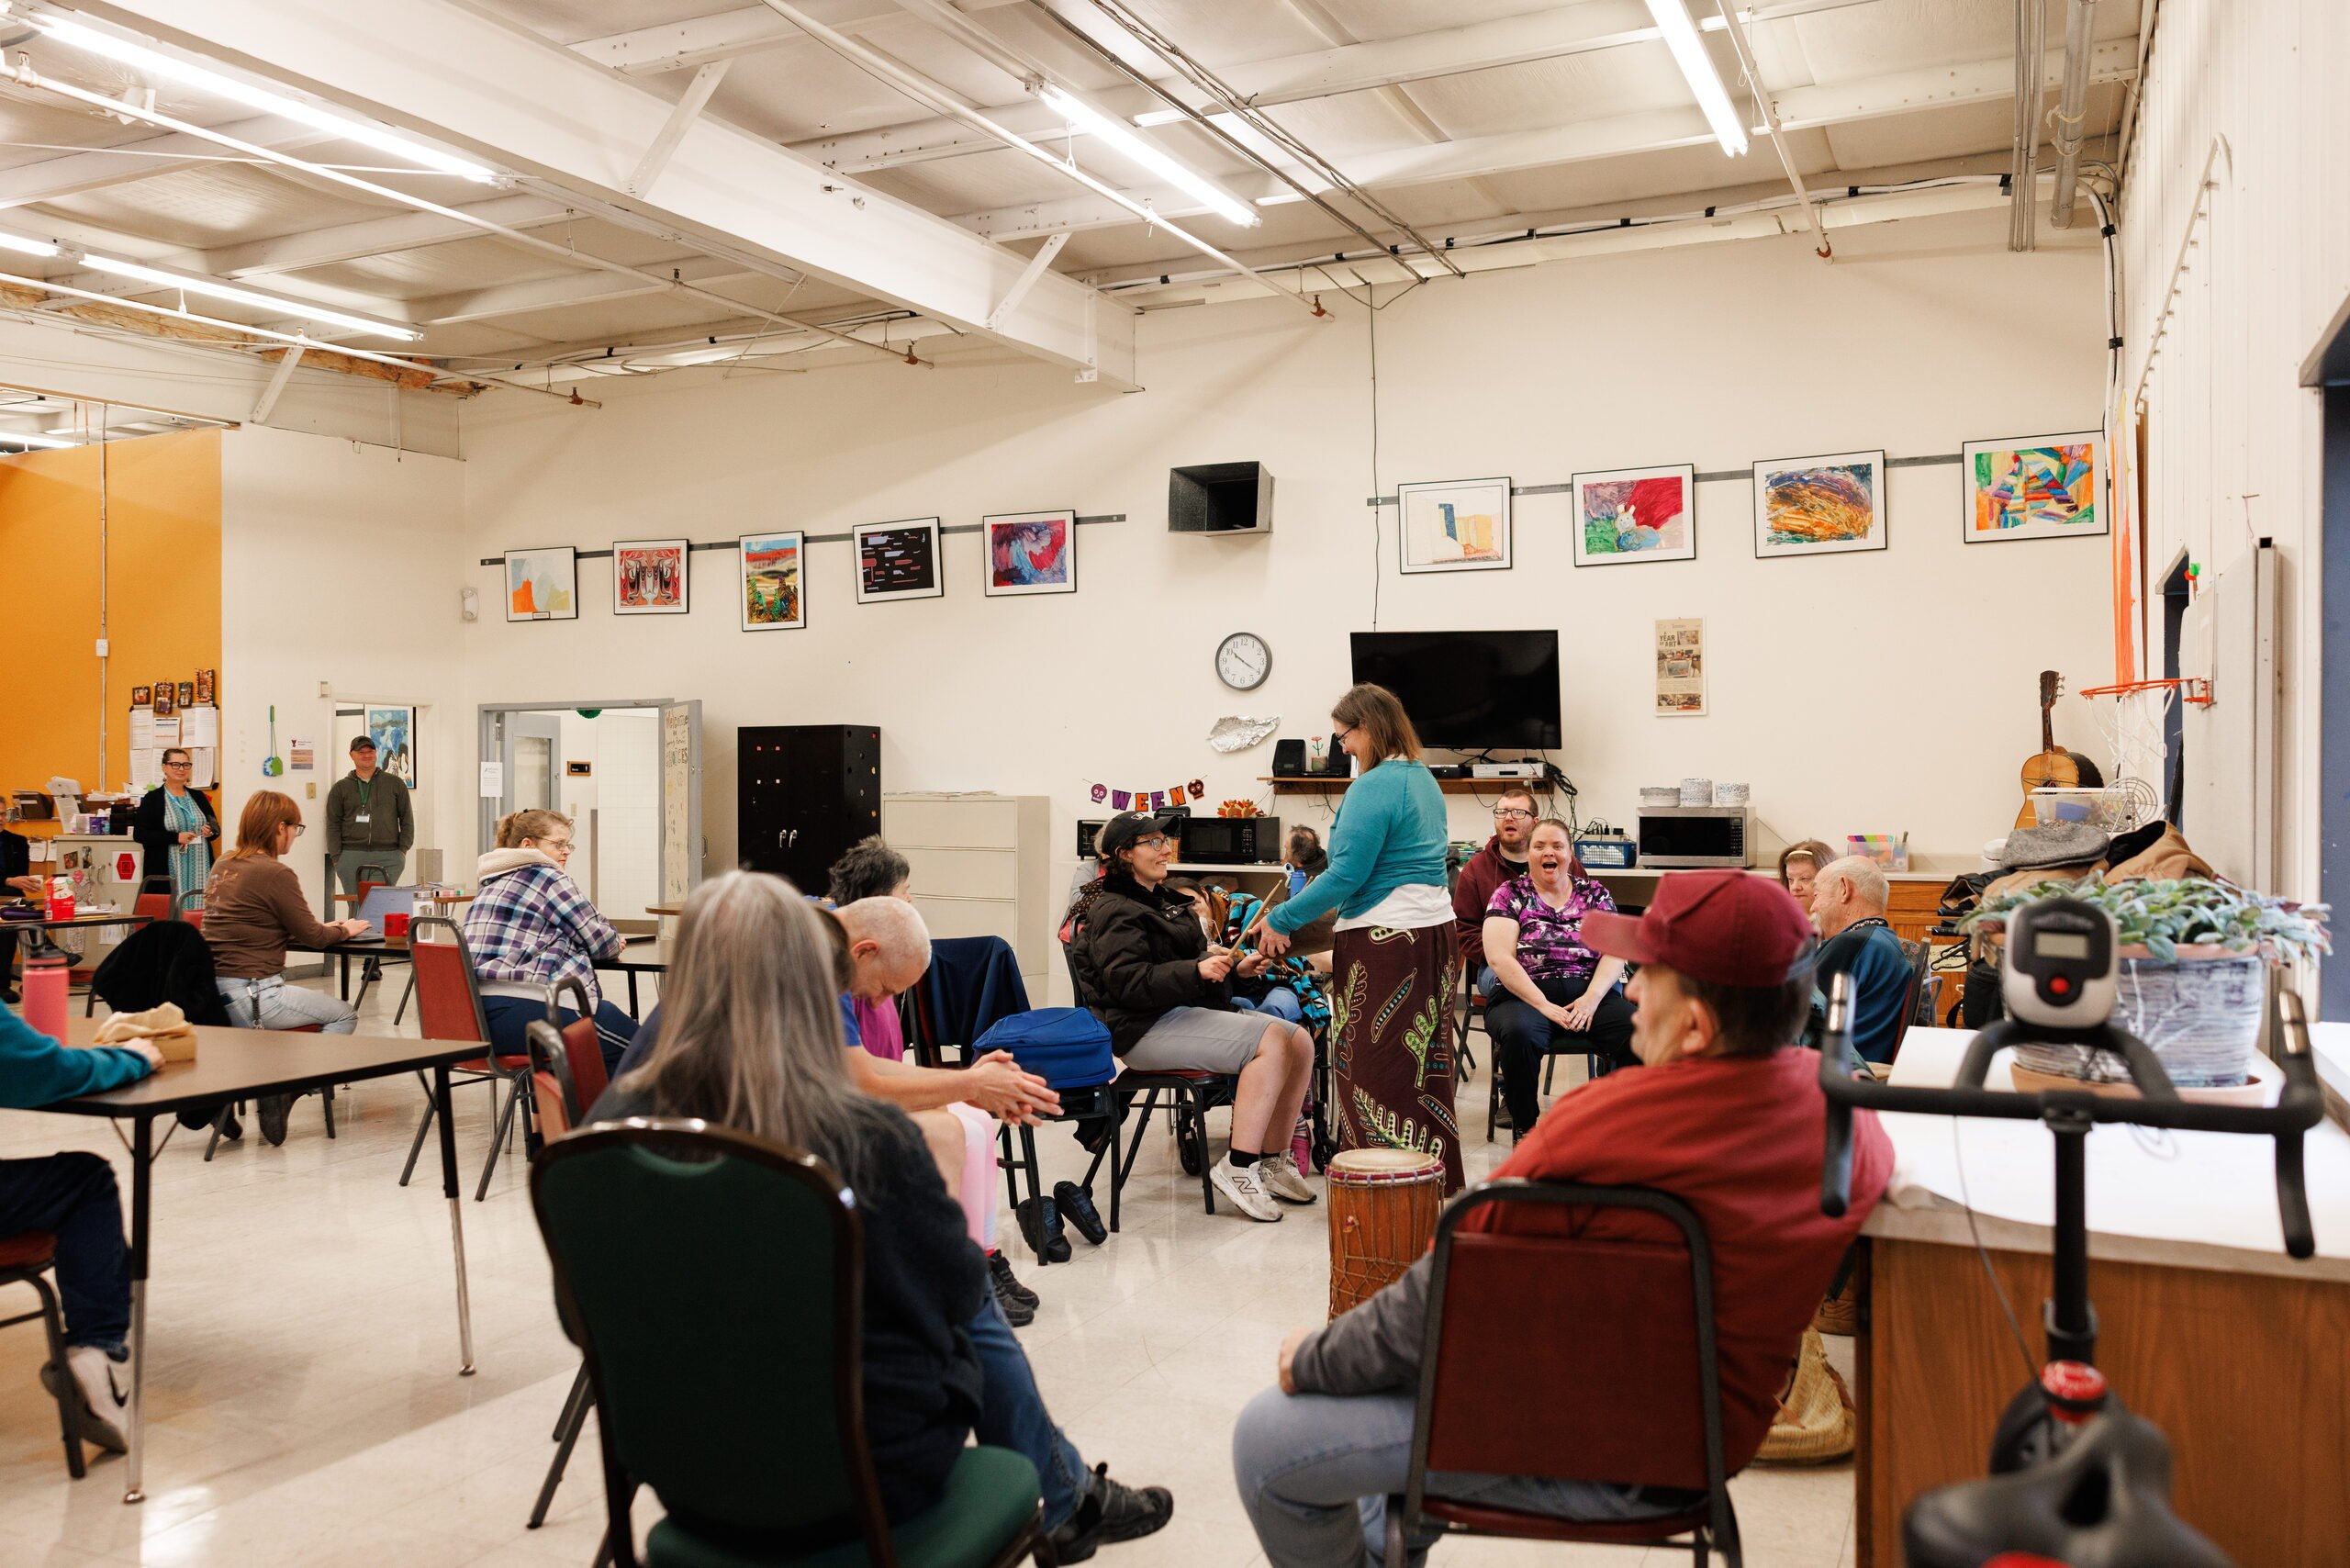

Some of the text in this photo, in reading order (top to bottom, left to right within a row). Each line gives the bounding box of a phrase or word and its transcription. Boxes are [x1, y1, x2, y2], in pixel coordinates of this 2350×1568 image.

[1240, 638, 1248, 646] 12
[1251, 639, 1255, 648] 1
[1257, 647, 1261, 655] 2
[1256, 667, 1260, 676] 4
[1112, 785, 1186, 812] WEEN
